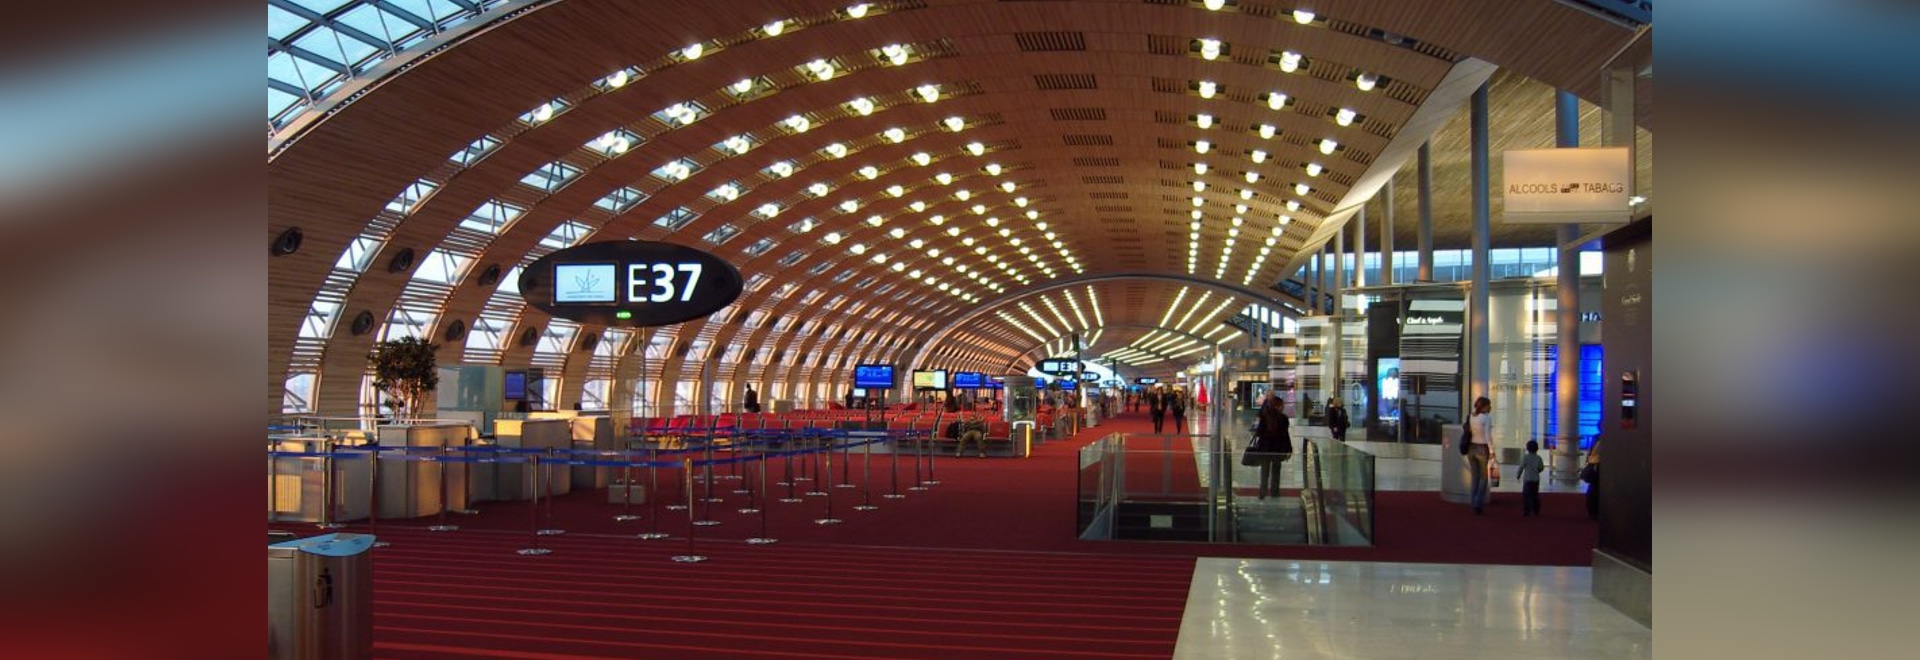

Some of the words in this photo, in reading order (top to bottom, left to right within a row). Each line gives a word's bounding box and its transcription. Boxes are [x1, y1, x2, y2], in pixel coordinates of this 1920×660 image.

[1509, 183, 1558, 194] ALCOOLS
[1583, 182, 1624, 194] TABACS
[627, 263, 702, 303] E37
